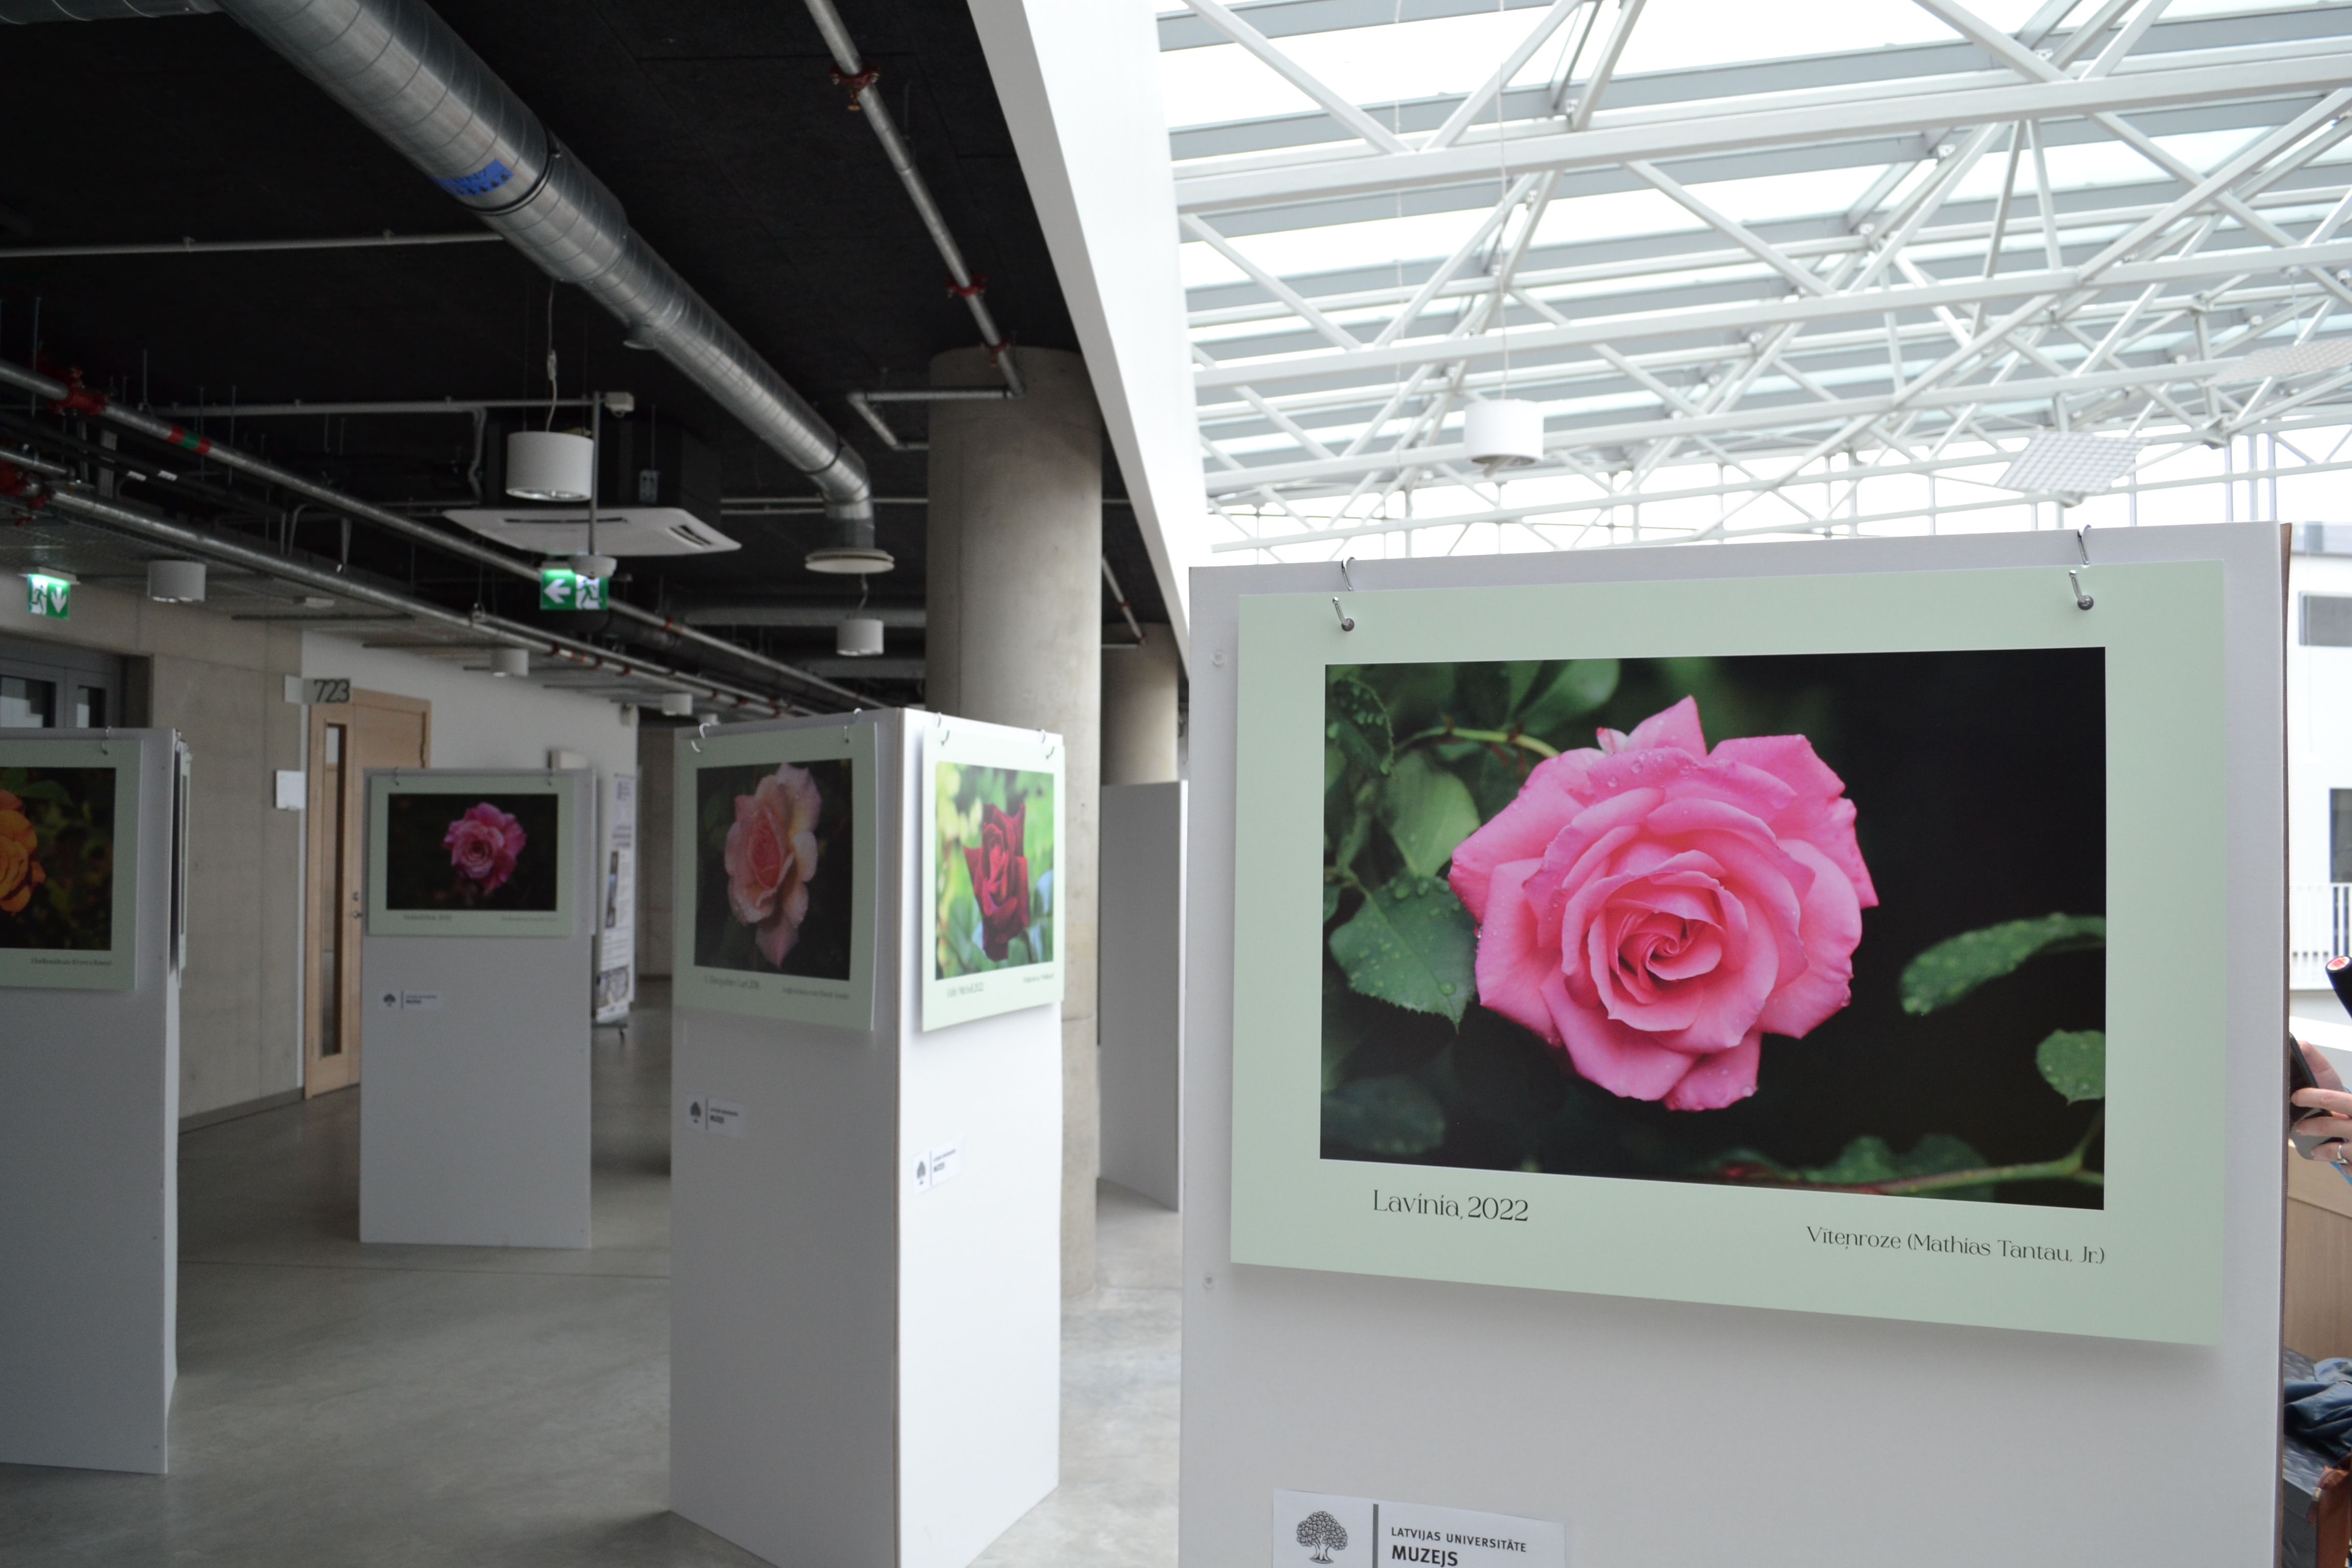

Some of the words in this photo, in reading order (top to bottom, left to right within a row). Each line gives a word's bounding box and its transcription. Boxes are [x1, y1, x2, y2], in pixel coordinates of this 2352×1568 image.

[314, 679, 350, 703] 723
[1374, 1189, 1463, 1220] Lavinia,
[1468, 1196, 1529, 1221] 2022
[1807, 1226, 1901, 1250] Vīteņroze
[1908, 1234, 1991, 1256] (Mathias
[2079, 1246, 2105, 1264] Jr.)
[1391, 1527, 1441, 1541] LATVIJAS
[1446, 1533, 1527, 1553] UNIVERSITĀTE
[1391, 1545, 1458, 1568] MUZEJS
